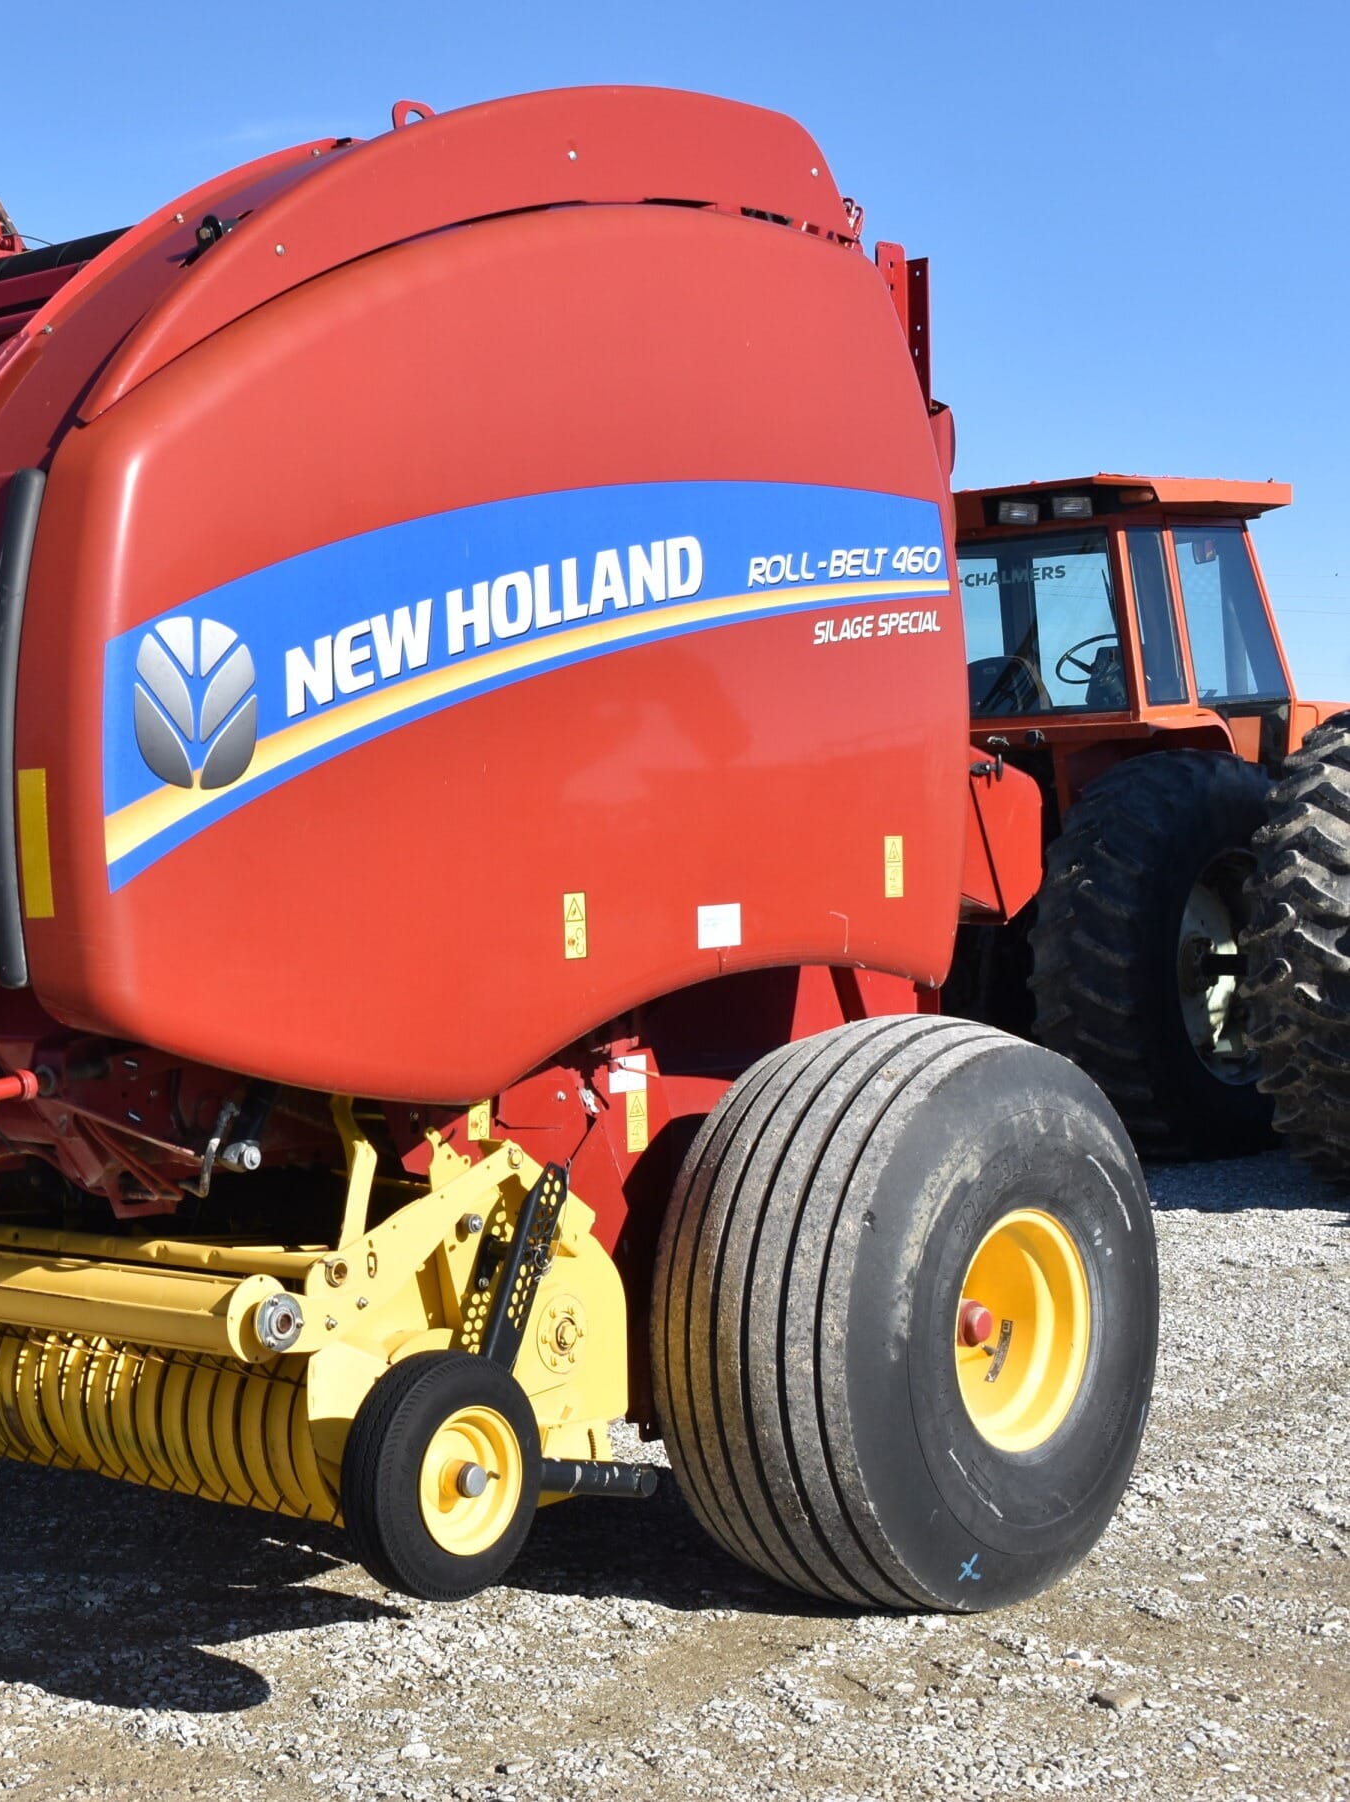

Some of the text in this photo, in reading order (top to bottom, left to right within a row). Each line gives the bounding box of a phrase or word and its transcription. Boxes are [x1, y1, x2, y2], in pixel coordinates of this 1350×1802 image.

[747, 546, 942, 588] ROLL-BELT 460
[285, 535, 704, 719] NEW HOLLAND
[813, 611, 941, 645] SILAGE SPECIAL
